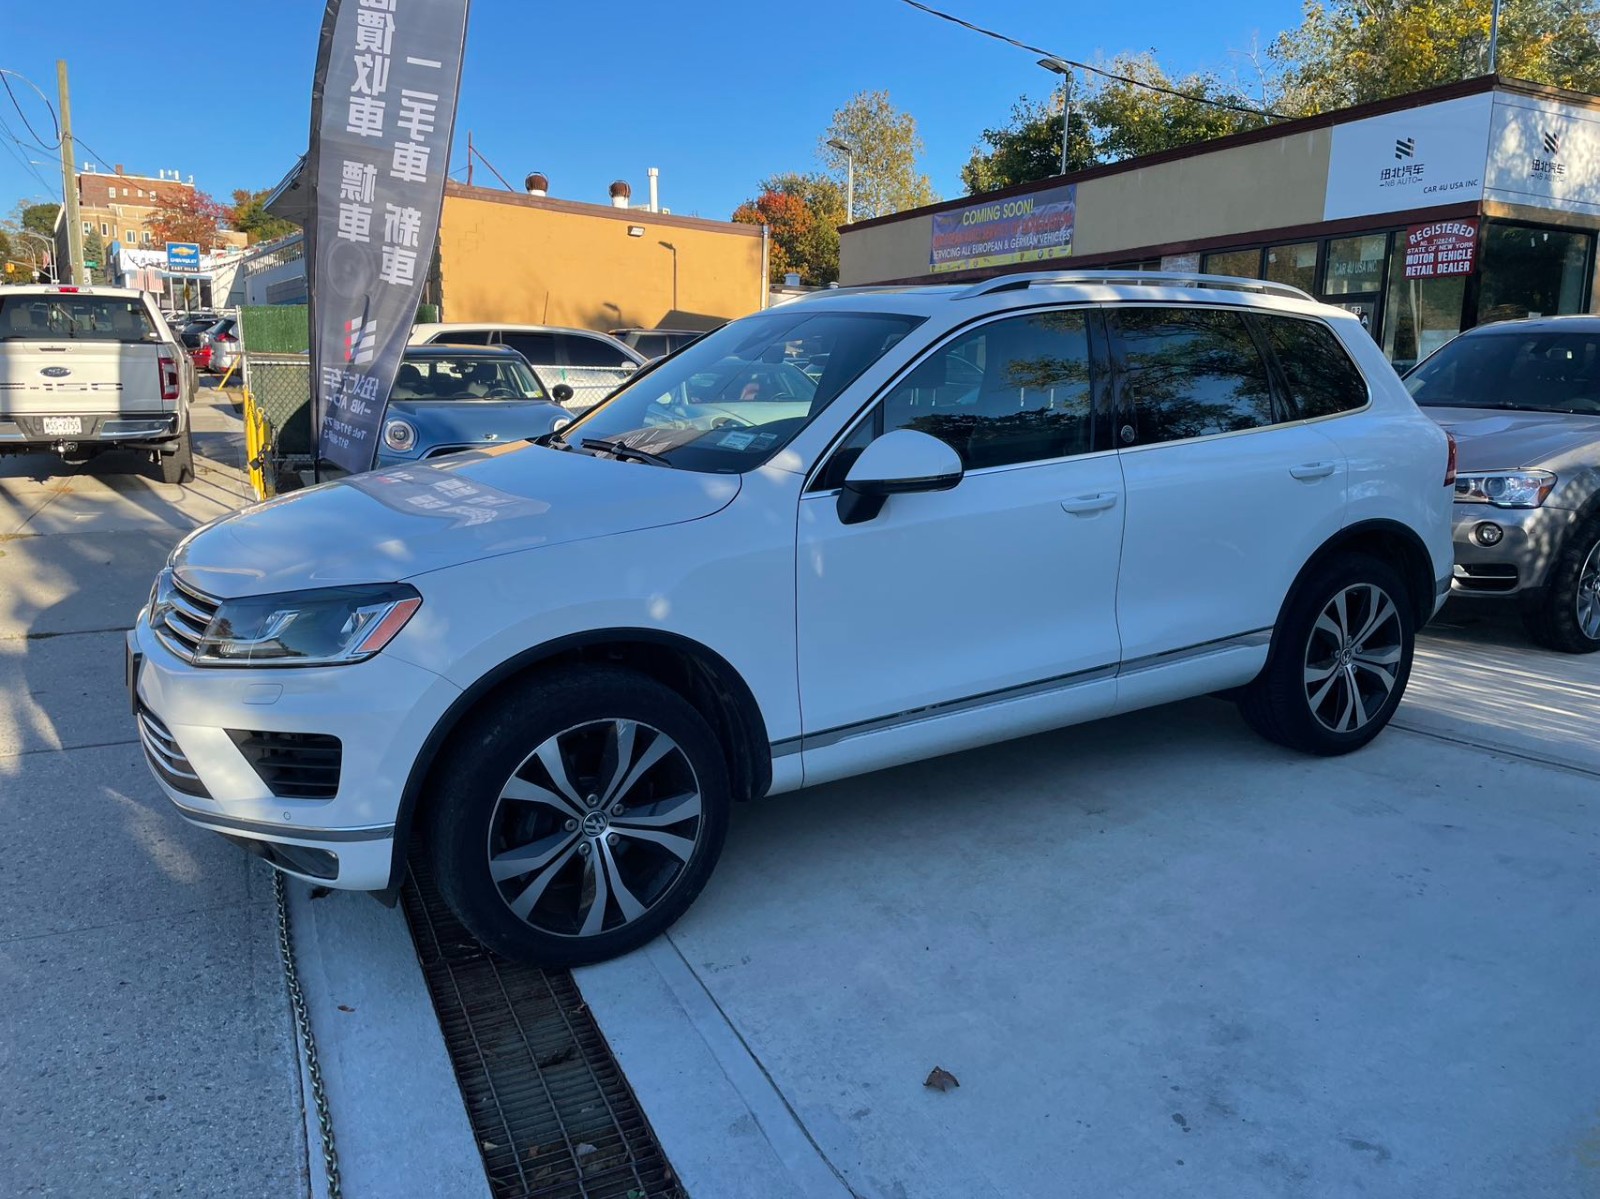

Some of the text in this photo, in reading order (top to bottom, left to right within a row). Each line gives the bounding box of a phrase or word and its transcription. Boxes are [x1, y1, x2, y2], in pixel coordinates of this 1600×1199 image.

[1423, 179, 1478, 194] CAR 4U USA INC
[962, 198, 1034, 226] COMING SOON!
[961, 246, 970, 255] ALL
[972, 240, 1003, 254] EUROPEAN
[1004, 242, 1009, 250] &
[1010, 233, 1039, 249] GERMAN
[1039, 230, 1071, 245] VEHICLES
[1409, 223, 1475, 245] REGISTERED
[1405, 248, 1473, 265] MOTOR VEHICLE
[1407, 246, 1426, 254] STATE
[1334, 262, 1346, 276] CAR
[1355, 261, 1367, 274] USA
[1405, 260, 1470, 277] RETAIL DEALER
